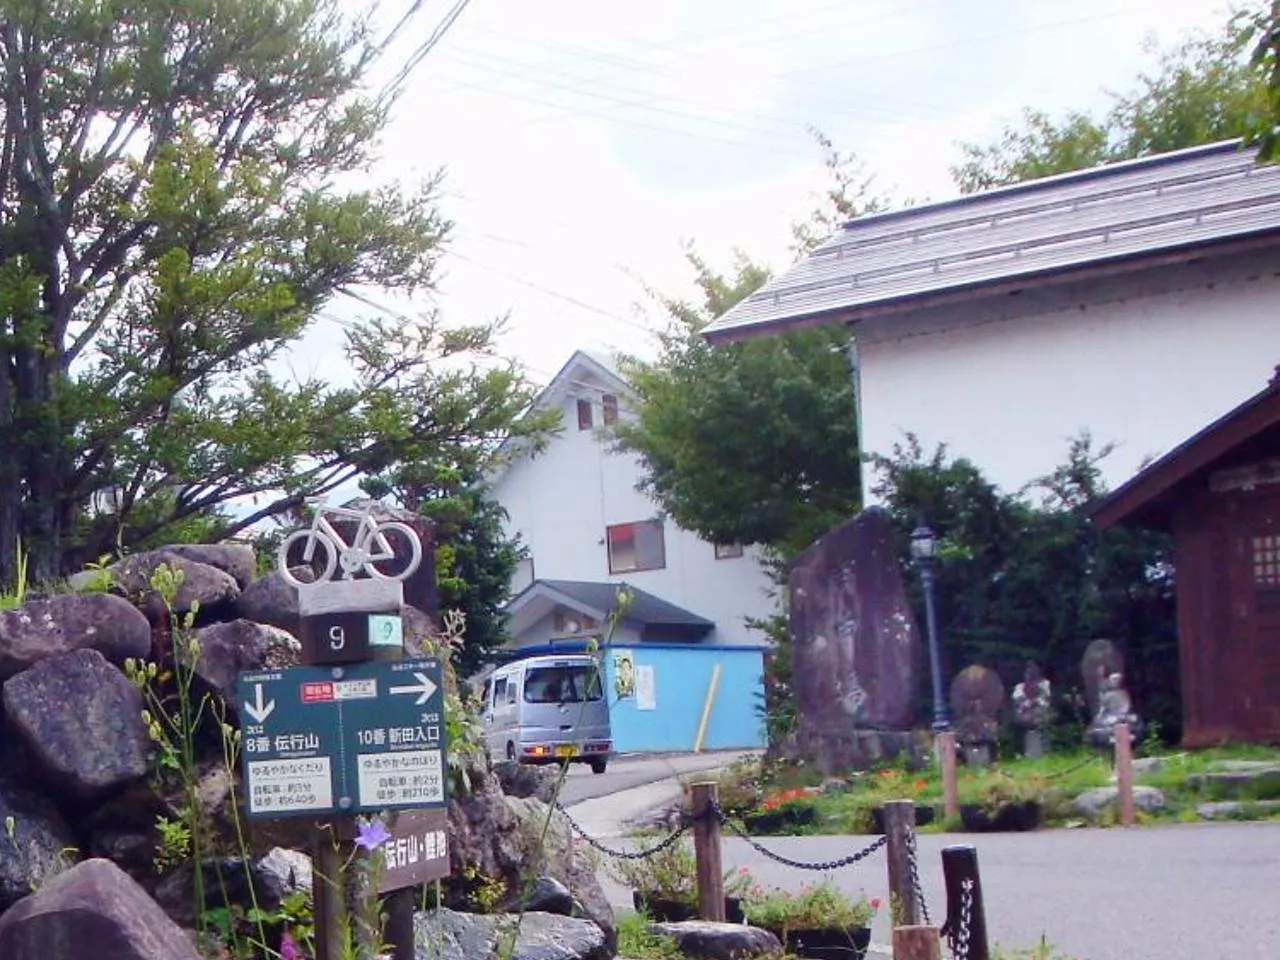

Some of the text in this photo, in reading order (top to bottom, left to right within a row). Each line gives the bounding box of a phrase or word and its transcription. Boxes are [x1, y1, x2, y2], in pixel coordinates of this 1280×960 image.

[329, 625, 345, 650] 9
[274, 732, 320, 751] 伝行山
